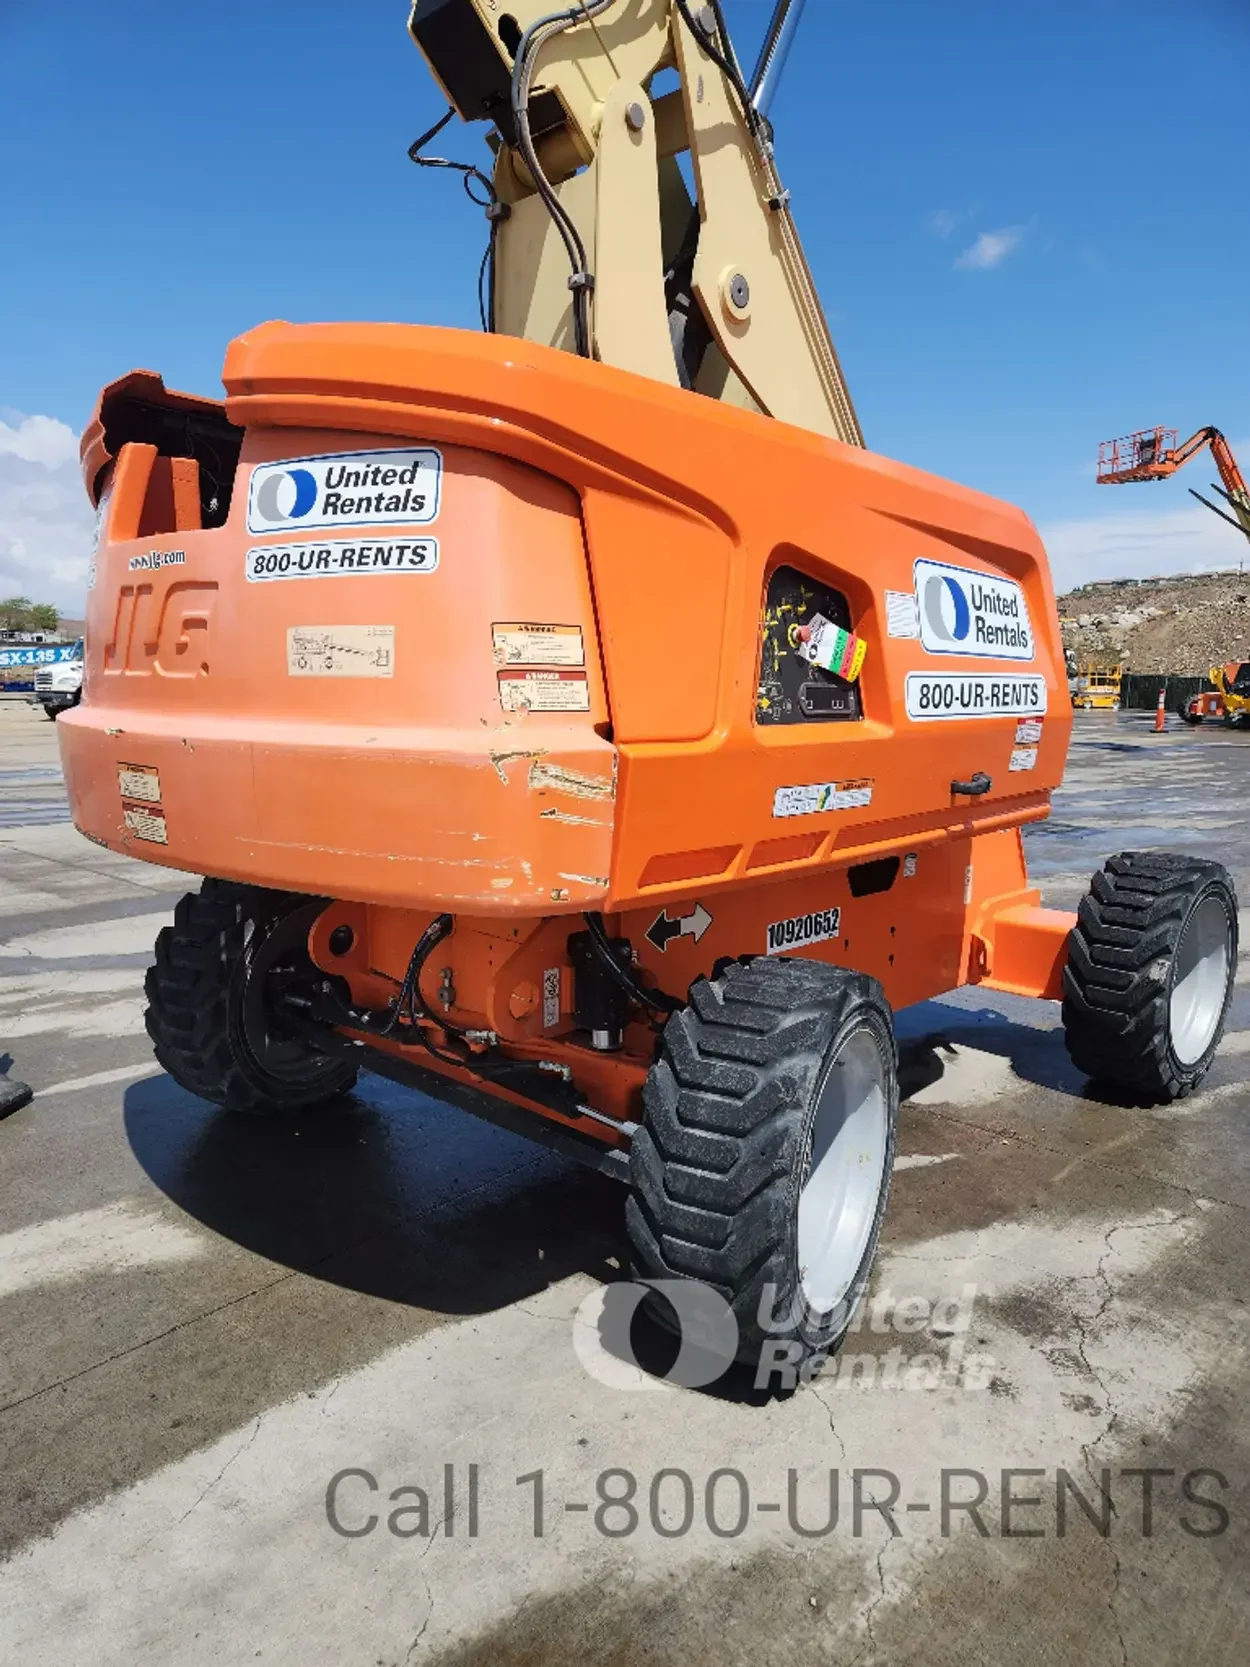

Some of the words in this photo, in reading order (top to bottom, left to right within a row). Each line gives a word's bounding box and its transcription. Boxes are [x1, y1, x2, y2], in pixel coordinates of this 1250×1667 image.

[325, 461, 419, 489] United
[322, 489, 426, 515] Rentals
[254, 545, 428, 574] 800-UR-RENTS
[971, 583, 1019, 618] United
[975, 615, 1028, 648] Rentals
[919, 682, 1039, 710] 800-UR-RENTS
[768, 908, 839, 948] 10920652
